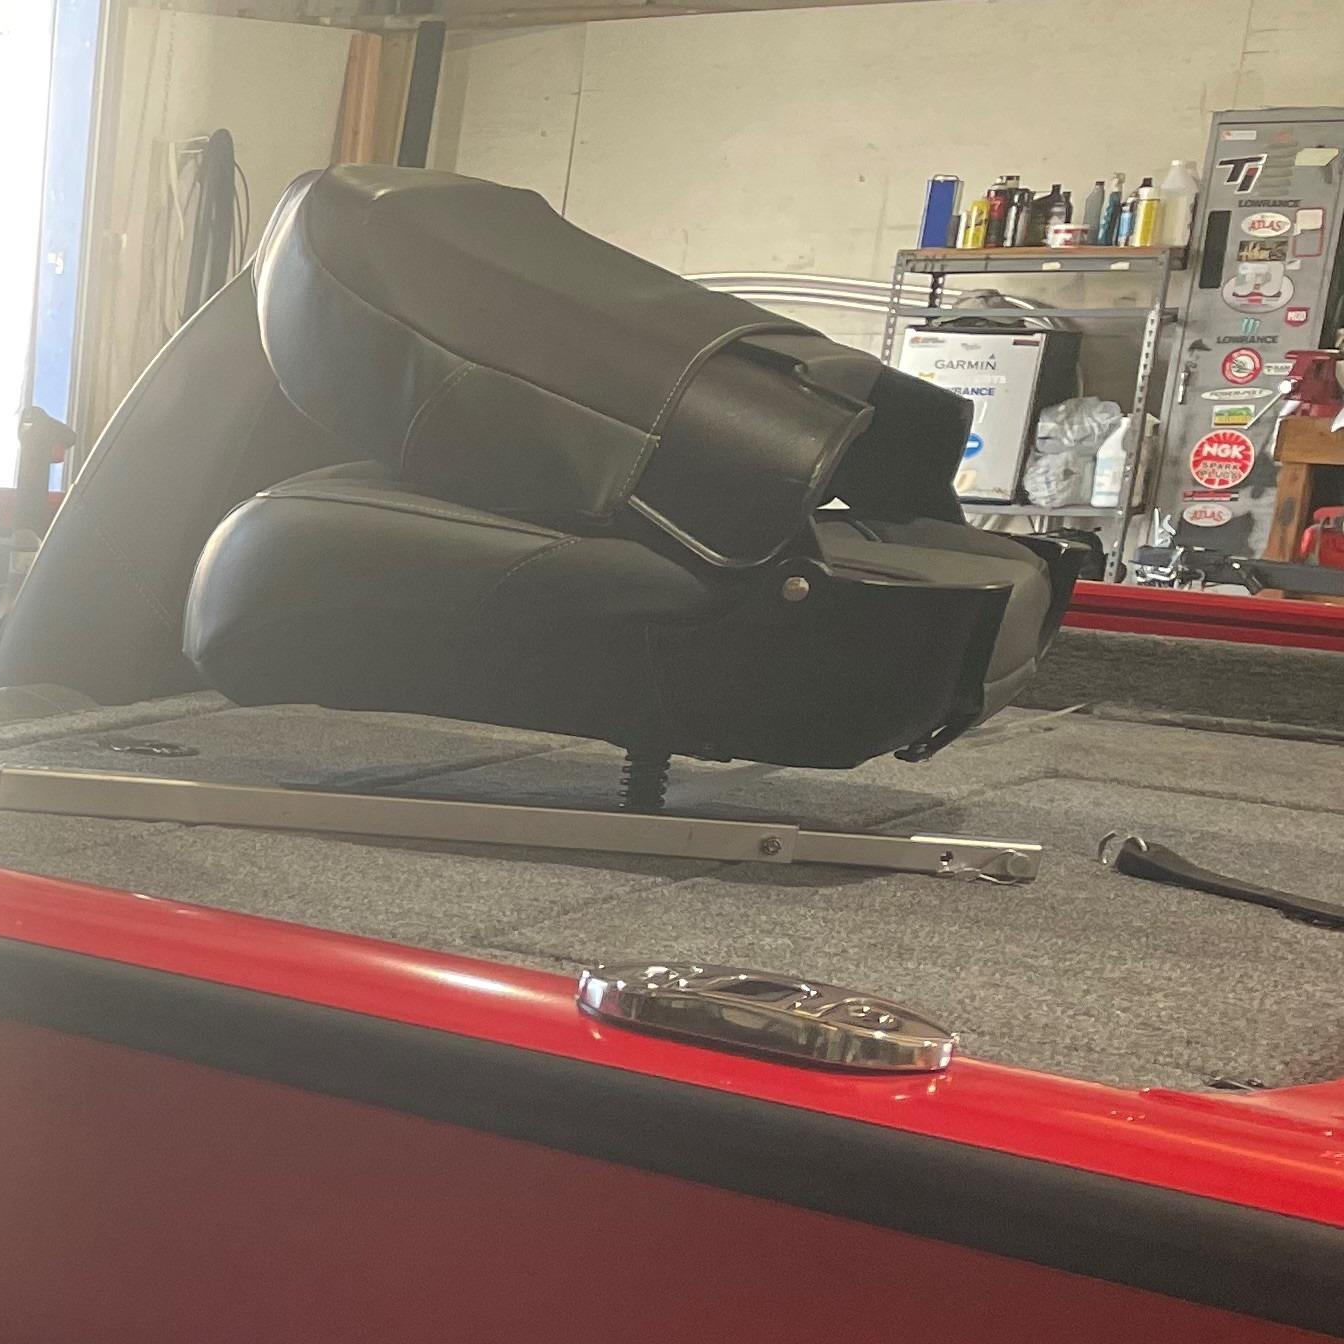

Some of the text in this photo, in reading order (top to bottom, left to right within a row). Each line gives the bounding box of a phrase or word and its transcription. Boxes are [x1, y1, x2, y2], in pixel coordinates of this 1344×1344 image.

[1248, 219, 1282, 232] ATLAS
[1216, 335, 1279, 344] LOWRANCE
[934, 359, 998, 371] GARMIN
[950, 387, 996, 397] RANCE
[1202, 443, 1246, 459] NGK
[1202, 461, 1239, 470] SPARK
[1200, 469, 1239, 480] PLUGS
[1190, 509, 1224, 522] ATLAS
